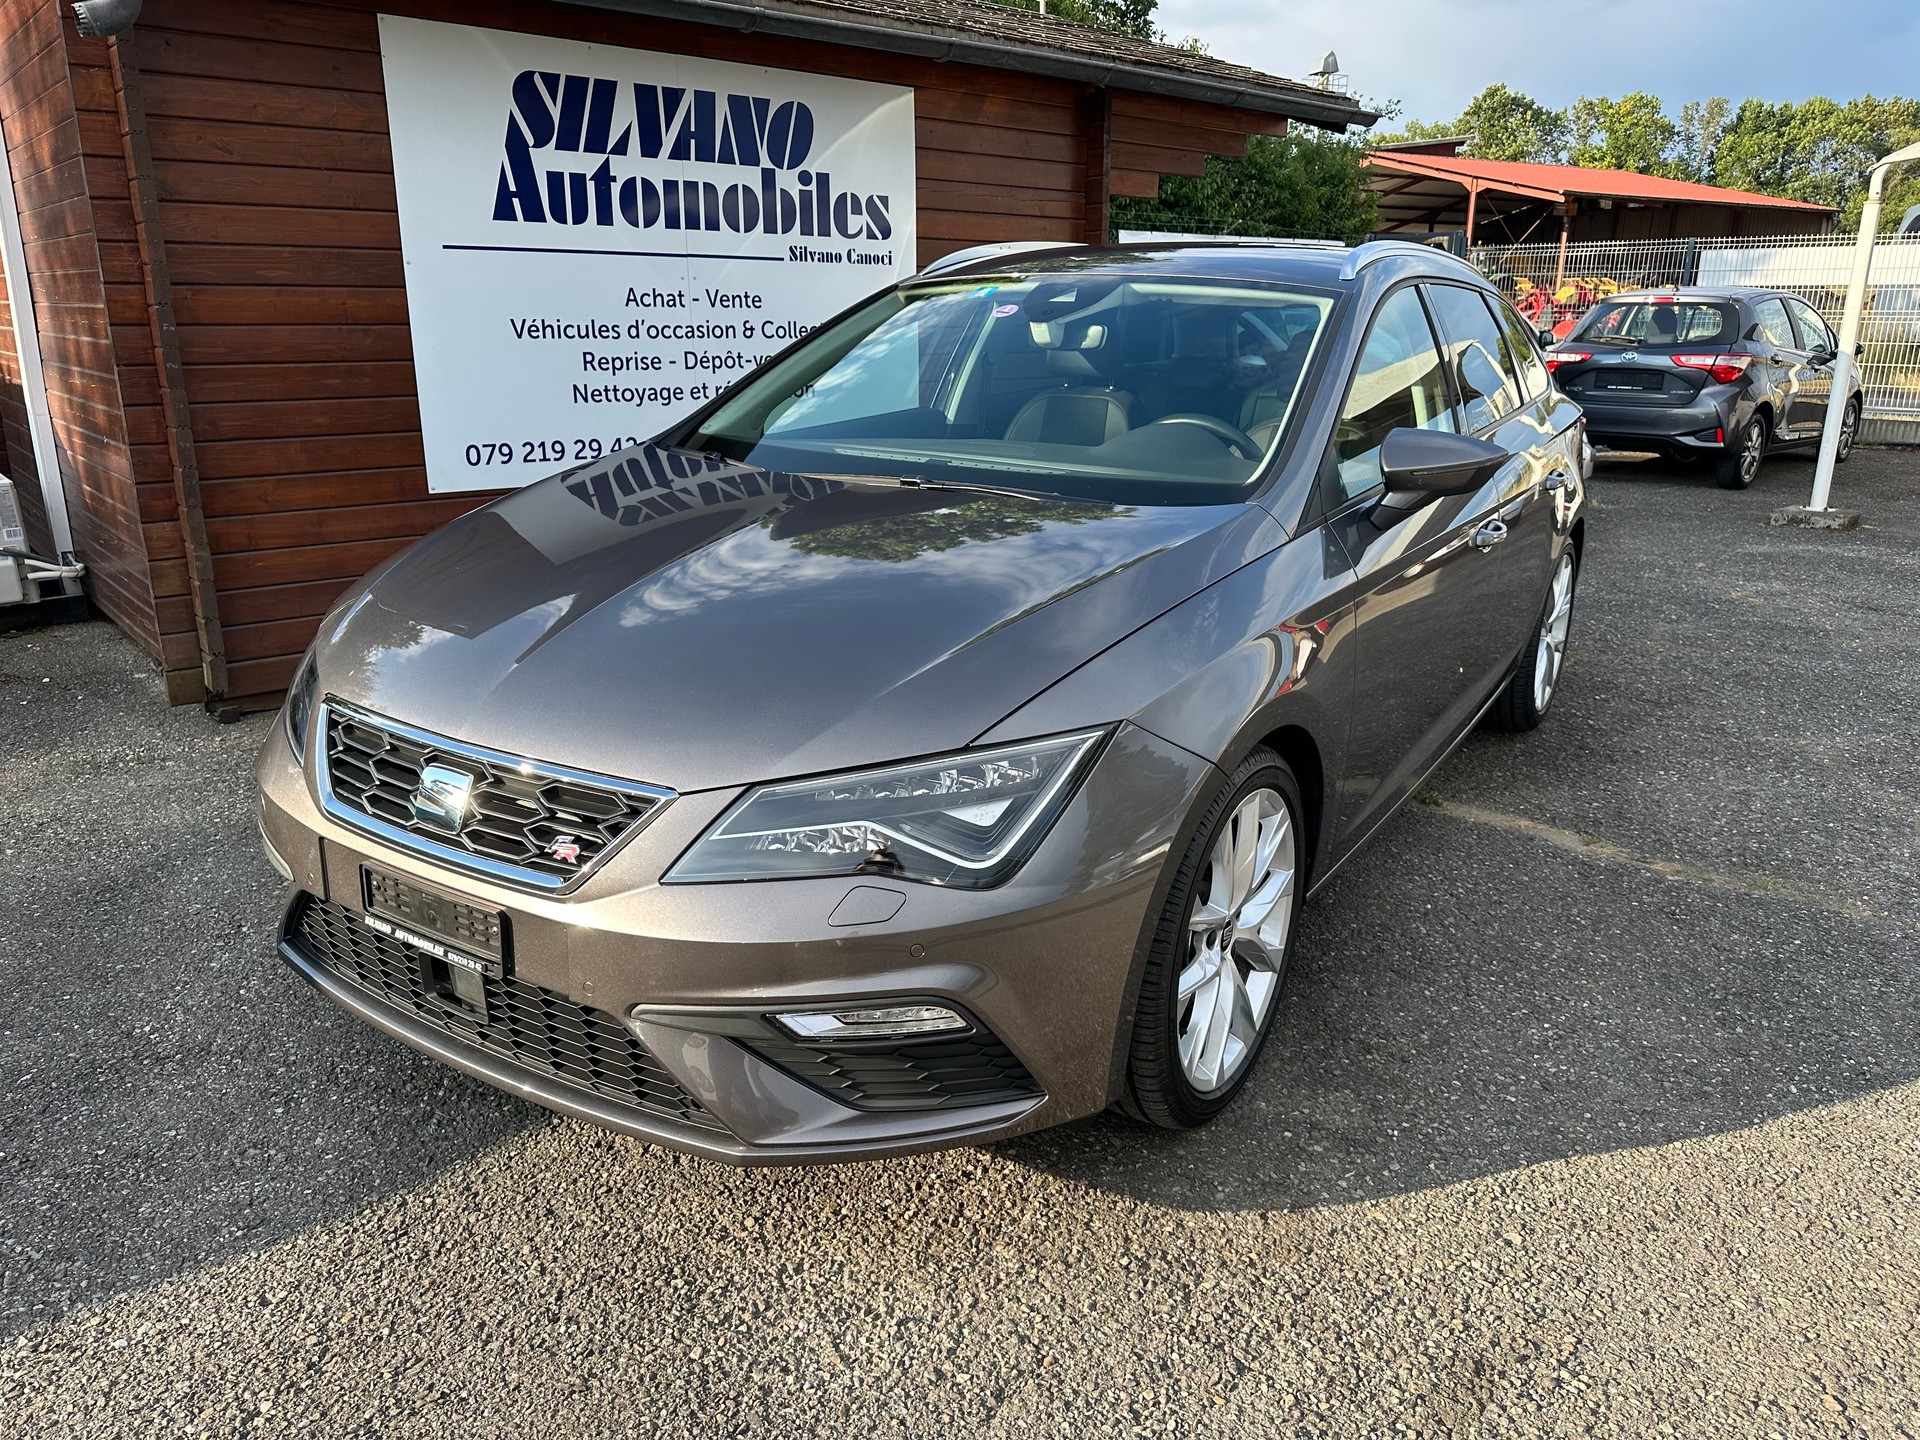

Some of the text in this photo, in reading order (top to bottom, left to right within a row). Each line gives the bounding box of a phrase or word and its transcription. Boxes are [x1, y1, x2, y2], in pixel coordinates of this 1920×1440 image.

[507, 70, 814, 170] SILVANO
[492, 142, 892, 241] Automobiles
[788, 245, 893, 266] Silvano Canoci
[624, 287, 686, 308] Achat
[704, 288, 763, 309] Vente
[509, 318, 621, 340] Véhicules
[742, 319, 756, 340] &
[582, 351, 662, 376] Reprise
[572, 383, 684, 408] Nettoyage
[689, 382, 710, 401] et
[465, 442, 514, 467] 079
[521, 439, 566, 464] 219
[573, 438, 603, 460] 29
